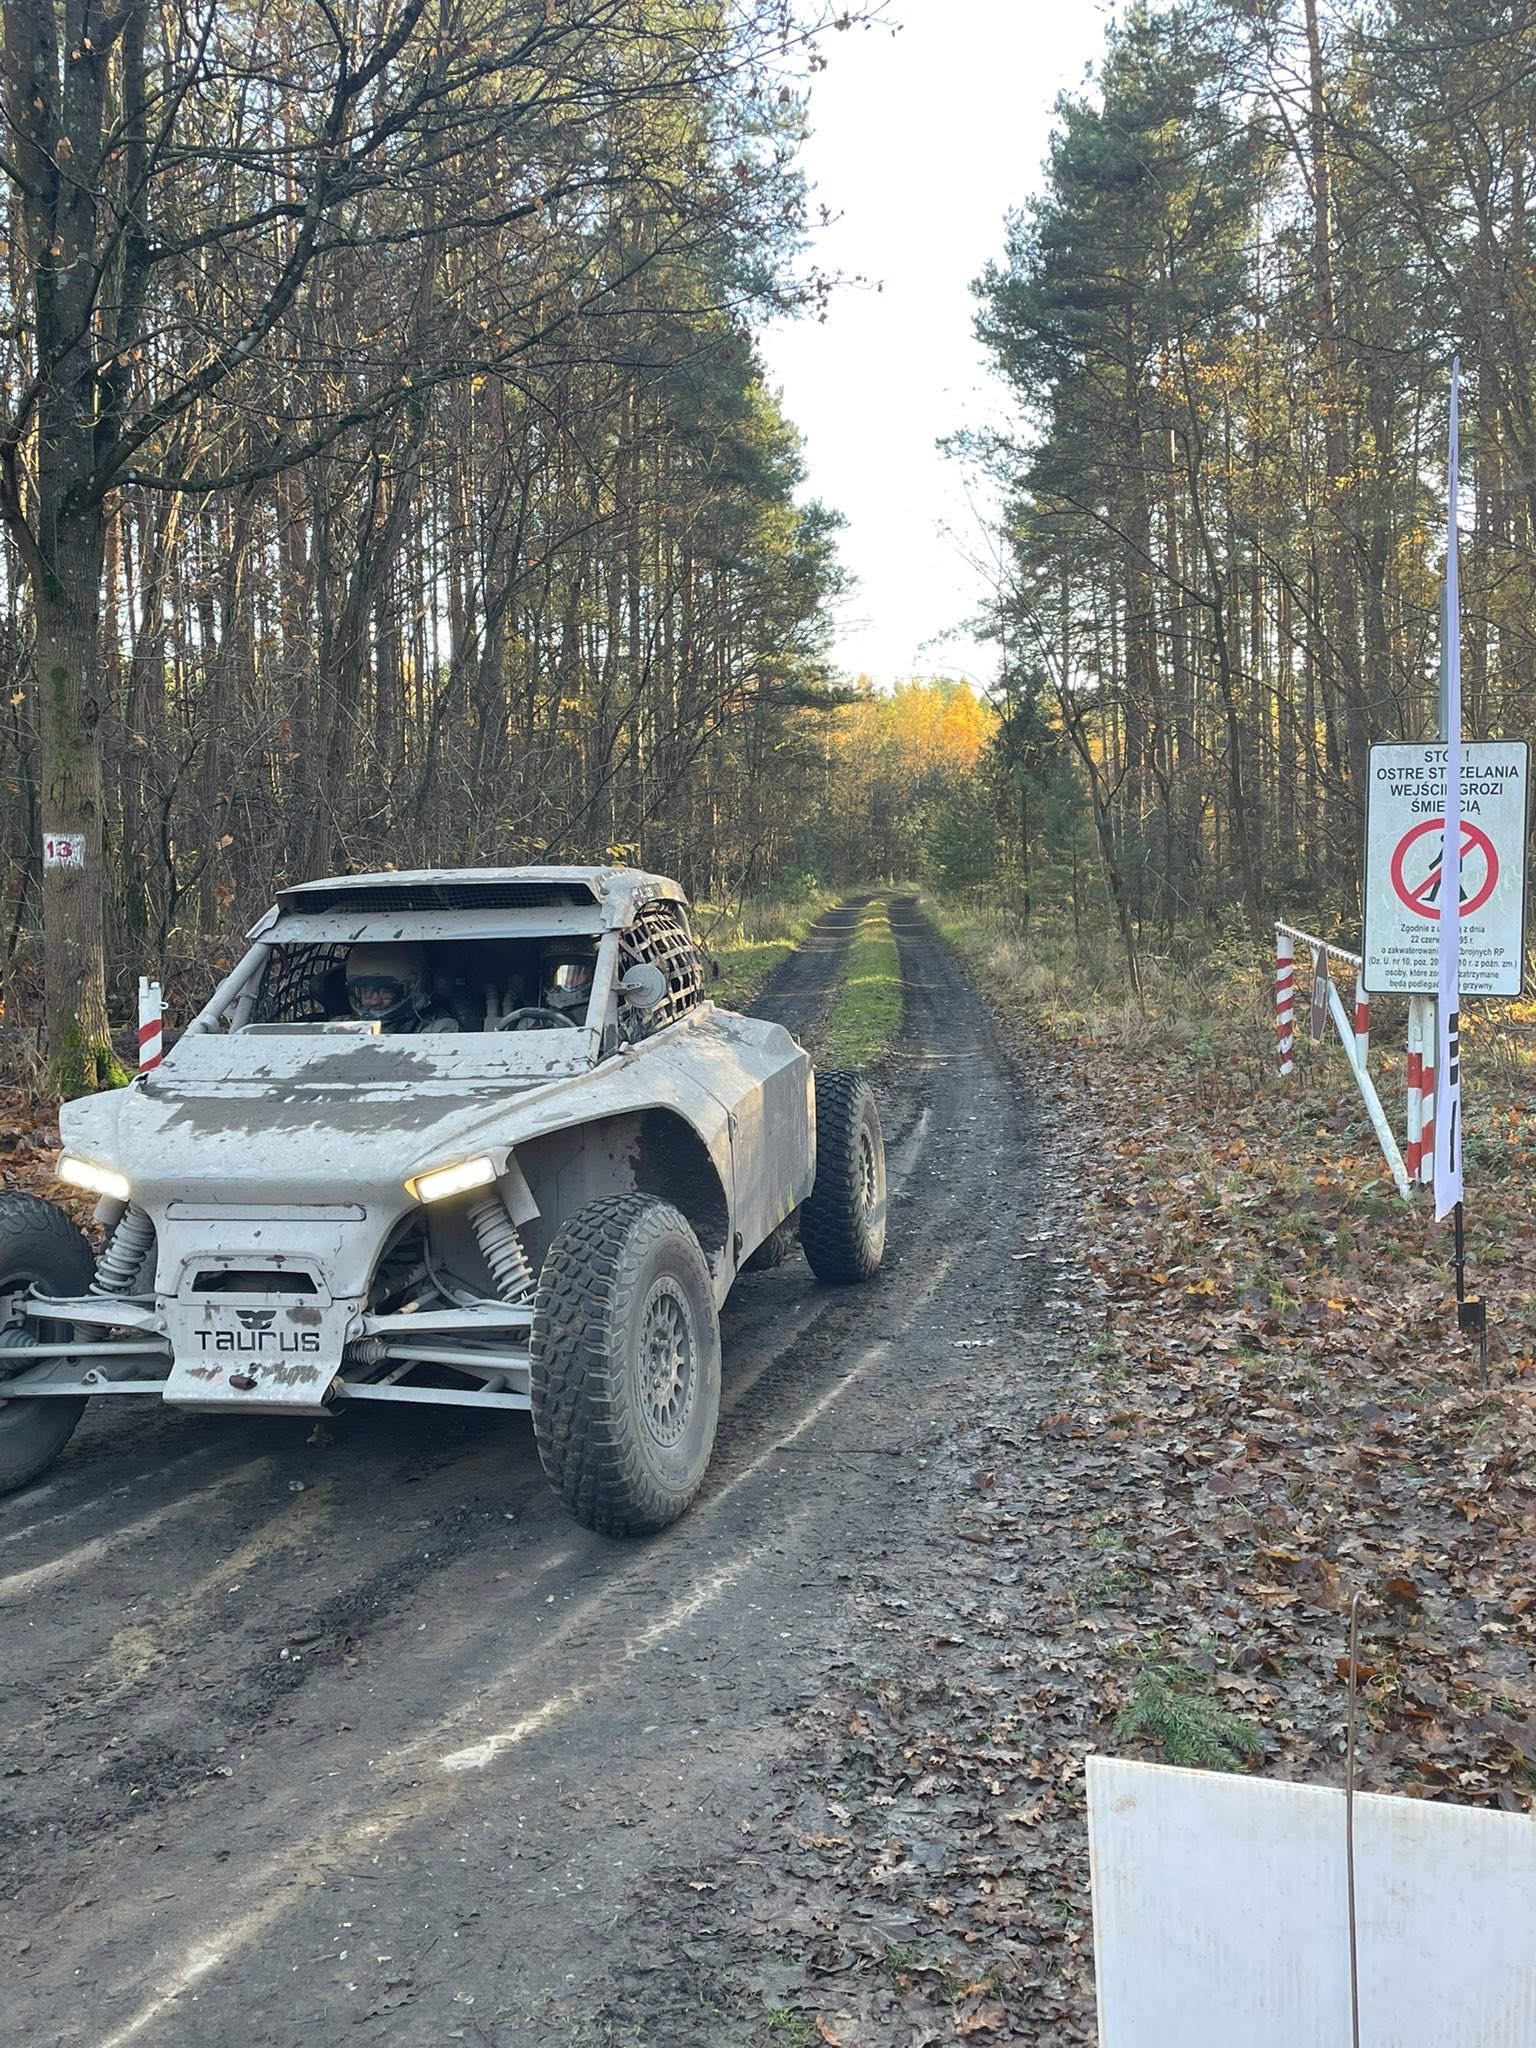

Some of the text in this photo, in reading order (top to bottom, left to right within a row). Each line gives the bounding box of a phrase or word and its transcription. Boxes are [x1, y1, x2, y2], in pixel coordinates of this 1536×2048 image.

[1377, 766, 1519, 780] OSTRE STZELANIA
[1390, 781, 1503, 796] WEJŚCI GROZI
[1411, 797, 1481, 815] ŚMIECIĄ
[47, 840, 73, 858] 13
[1400, 924, 1429, 934] Zgodnie
[1469, 925, 1485, 933] dnia
[1411, 935, 1419, 943] 22
[1387, 946, 1440, 954] zakwaterowani
[1493, 947, 1505, 956] RP
[1458, 971, 1499, 980] zatrzymane
